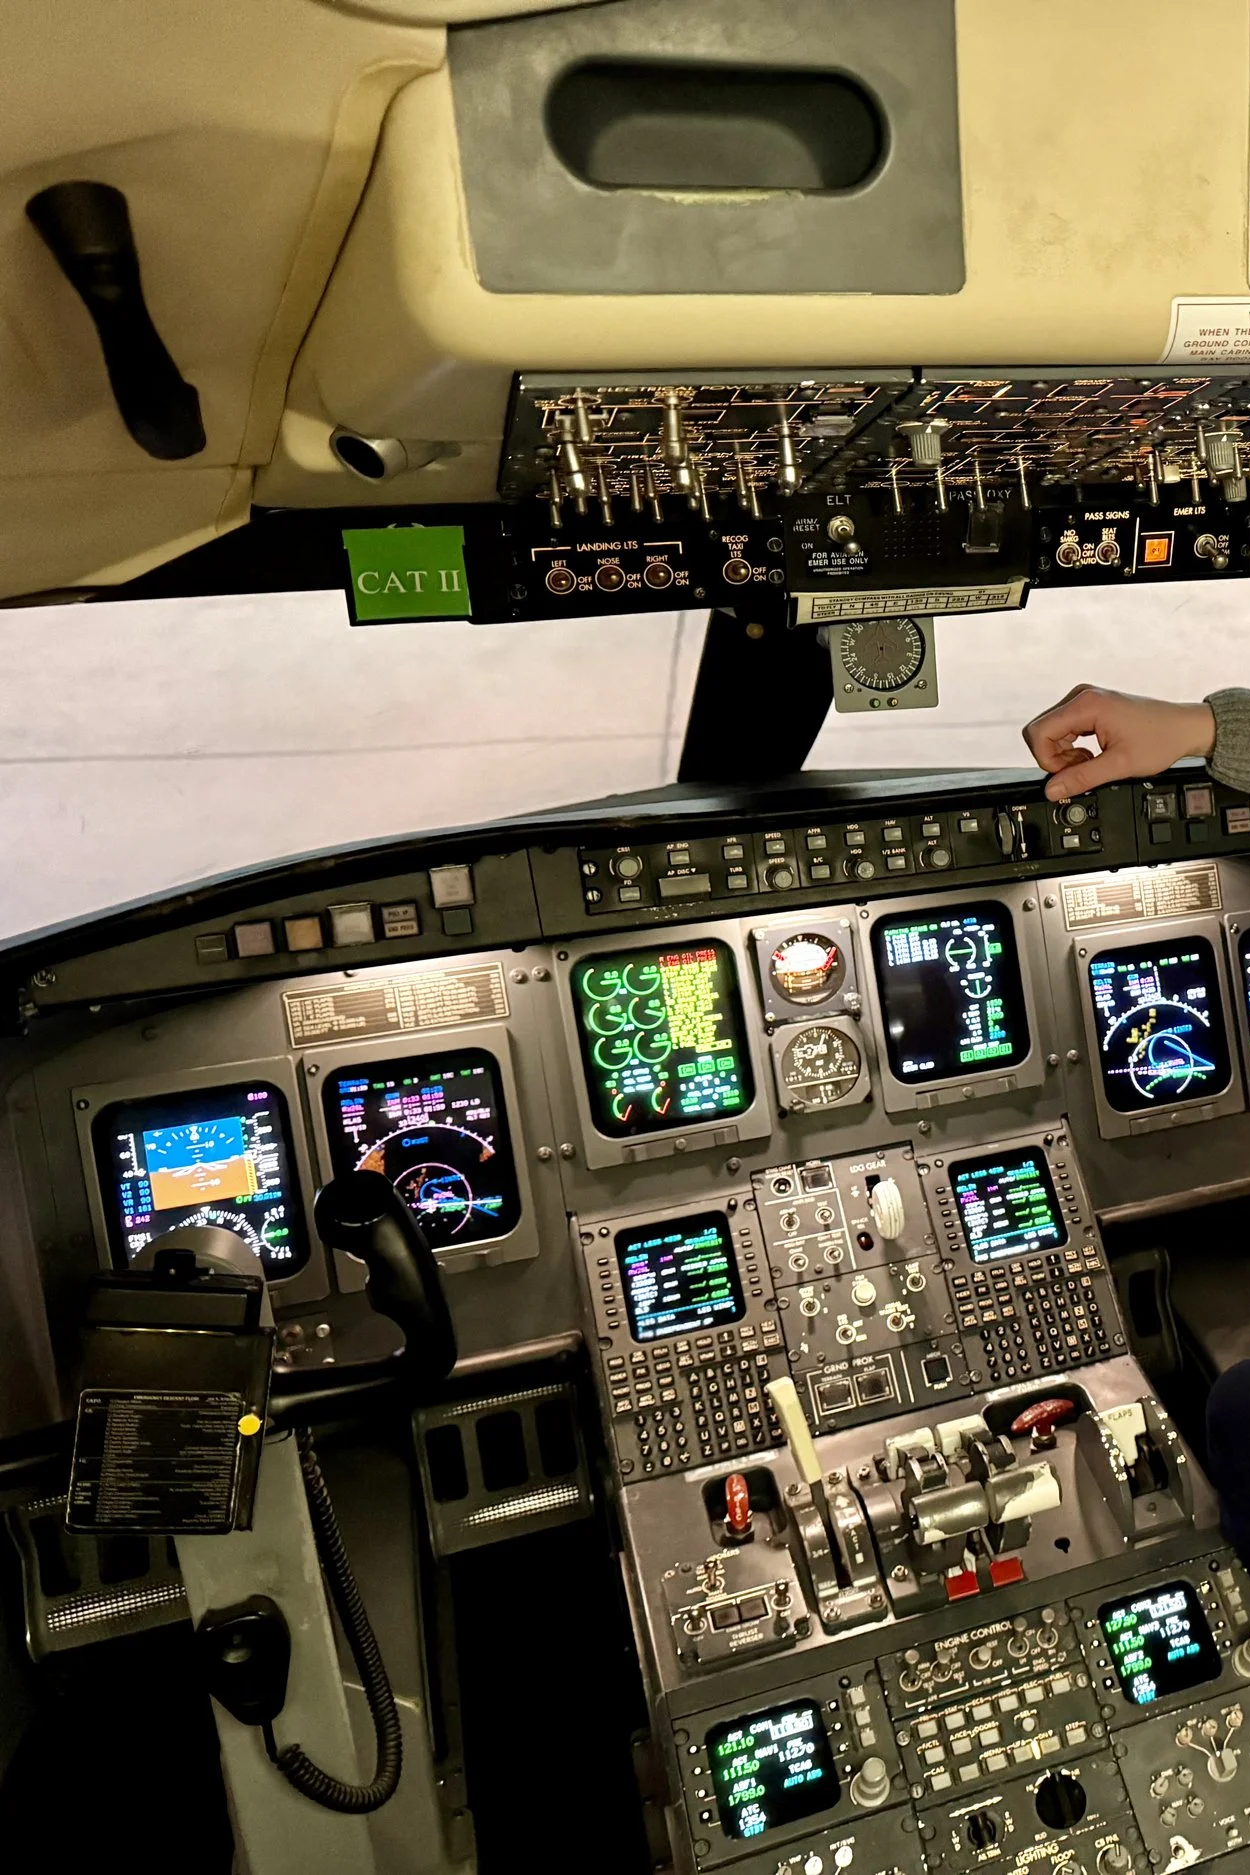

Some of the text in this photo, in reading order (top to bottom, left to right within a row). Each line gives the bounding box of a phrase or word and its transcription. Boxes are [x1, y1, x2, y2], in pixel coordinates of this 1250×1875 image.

[1199, 328, 1229, 336] WHEN
[1184, 340, 1229, 348] GROUND
[827, 495, 851, 505] ELT
[1085, 511, 1130, 520] PASS SIGNS
[1174, 506, 1205, 516] EMER LTS
[722, 535, 749, 543] RECOG
[577, 541, 638, 551] LANDING LTS
[598, 557, 620, 565] NOSE
[646, 555, 668, 563] RIGHT
[809, 558, 828, 566] EMER
[850, 557, 868, 565] ONLY
[578, 576, 592, 584] OFF
[627, 573, 641, 581] OFF
[675, 571, 689, 579] OFF
[753, 574, 767, 582] ON
[357, 569, 460, 595] CAT II
[850, 1160, 886, 1173] LDG GEAR
[824, 1356, 874, 1374] GRND PROX
[934, 1621, 1013, 1651] ENGINE CONTROL
[992, 1659, 1003, 1668] OFF
[717, 1736, 755, 1756] 121.10
[789, 1759, 812, 1774] TCAS
[931, 1766, 944, 1776] CAS
[741, 1803, 760, 1818] ATC
[1095, 1838, 1105, 1848] CB
[1015, 1842, 1059, 1866] LIGHTING
